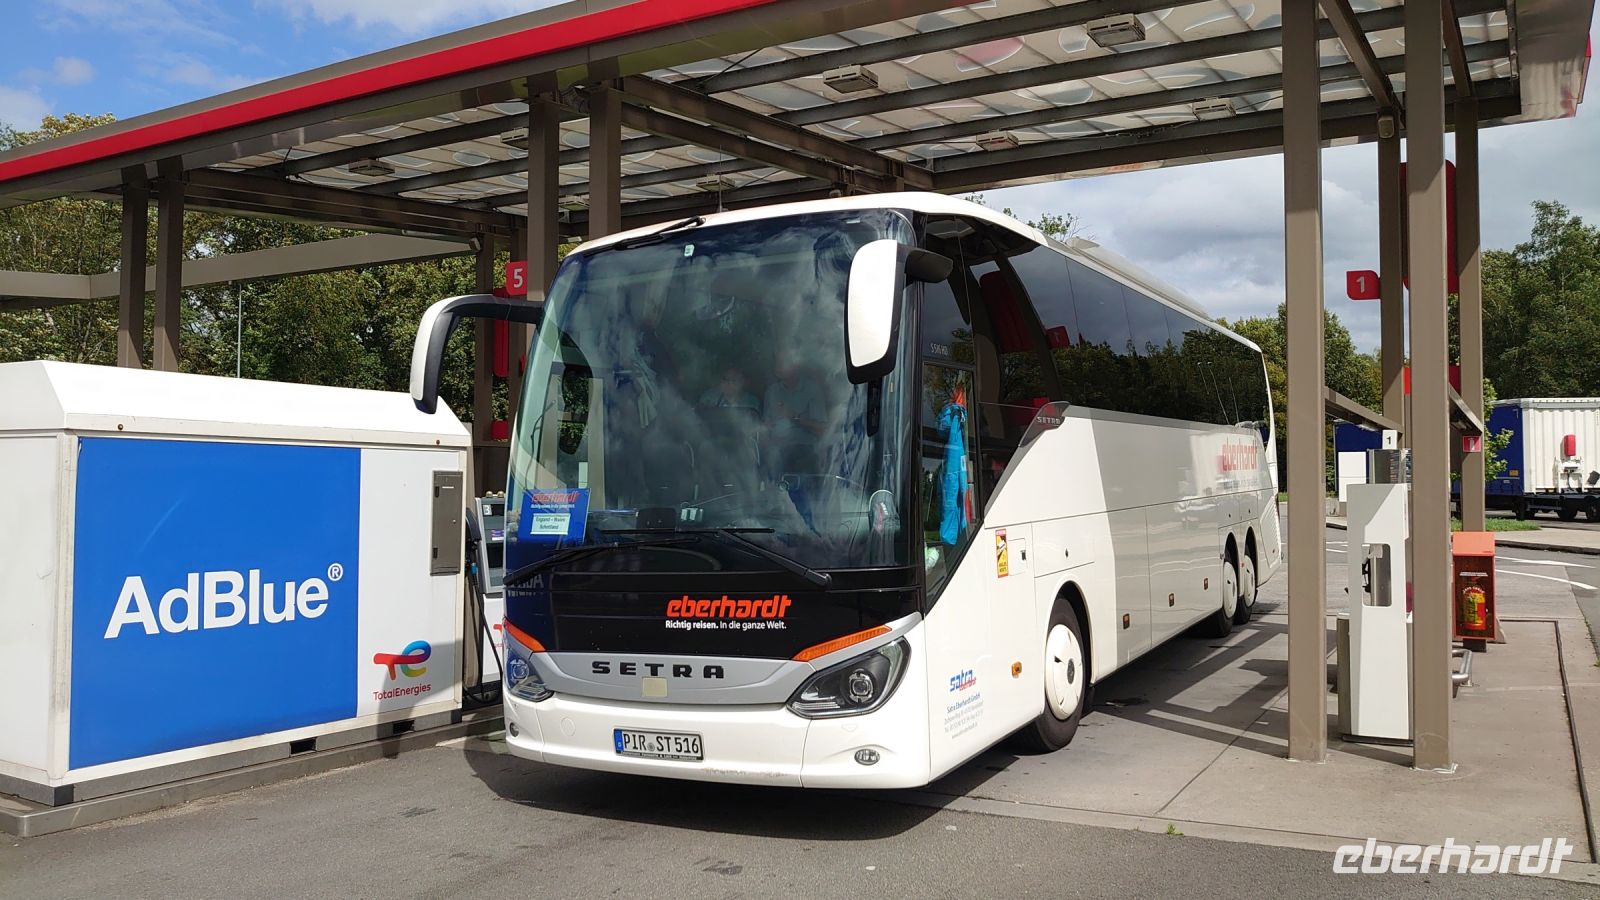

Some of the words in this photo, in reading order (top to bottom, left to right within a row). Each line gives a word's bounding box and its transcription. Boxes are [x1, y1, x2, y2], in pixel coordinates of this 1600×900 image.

[513, 268, 523, 288] 5
[1356, 276, 1365, 294] 1
[1037, 416, 1061, 424] SETRA
[1386, 436, 1391, 445] 1
[666, 594, 792, 618] eberhardt
[665, 620, 691, 631] Richtig
[693, 620, 719, 629] reisen.
[720, 621, 727, 629] In
[729, 621, 740, 629] die
[742, 622, 765, 631] ganze
[767, 620, 786, 629] Welt.
[591, 660, 725, 679] SETRA
[373, 684, 431, 700] TotalEnergies
[623, 733, 647, 751] PIR
